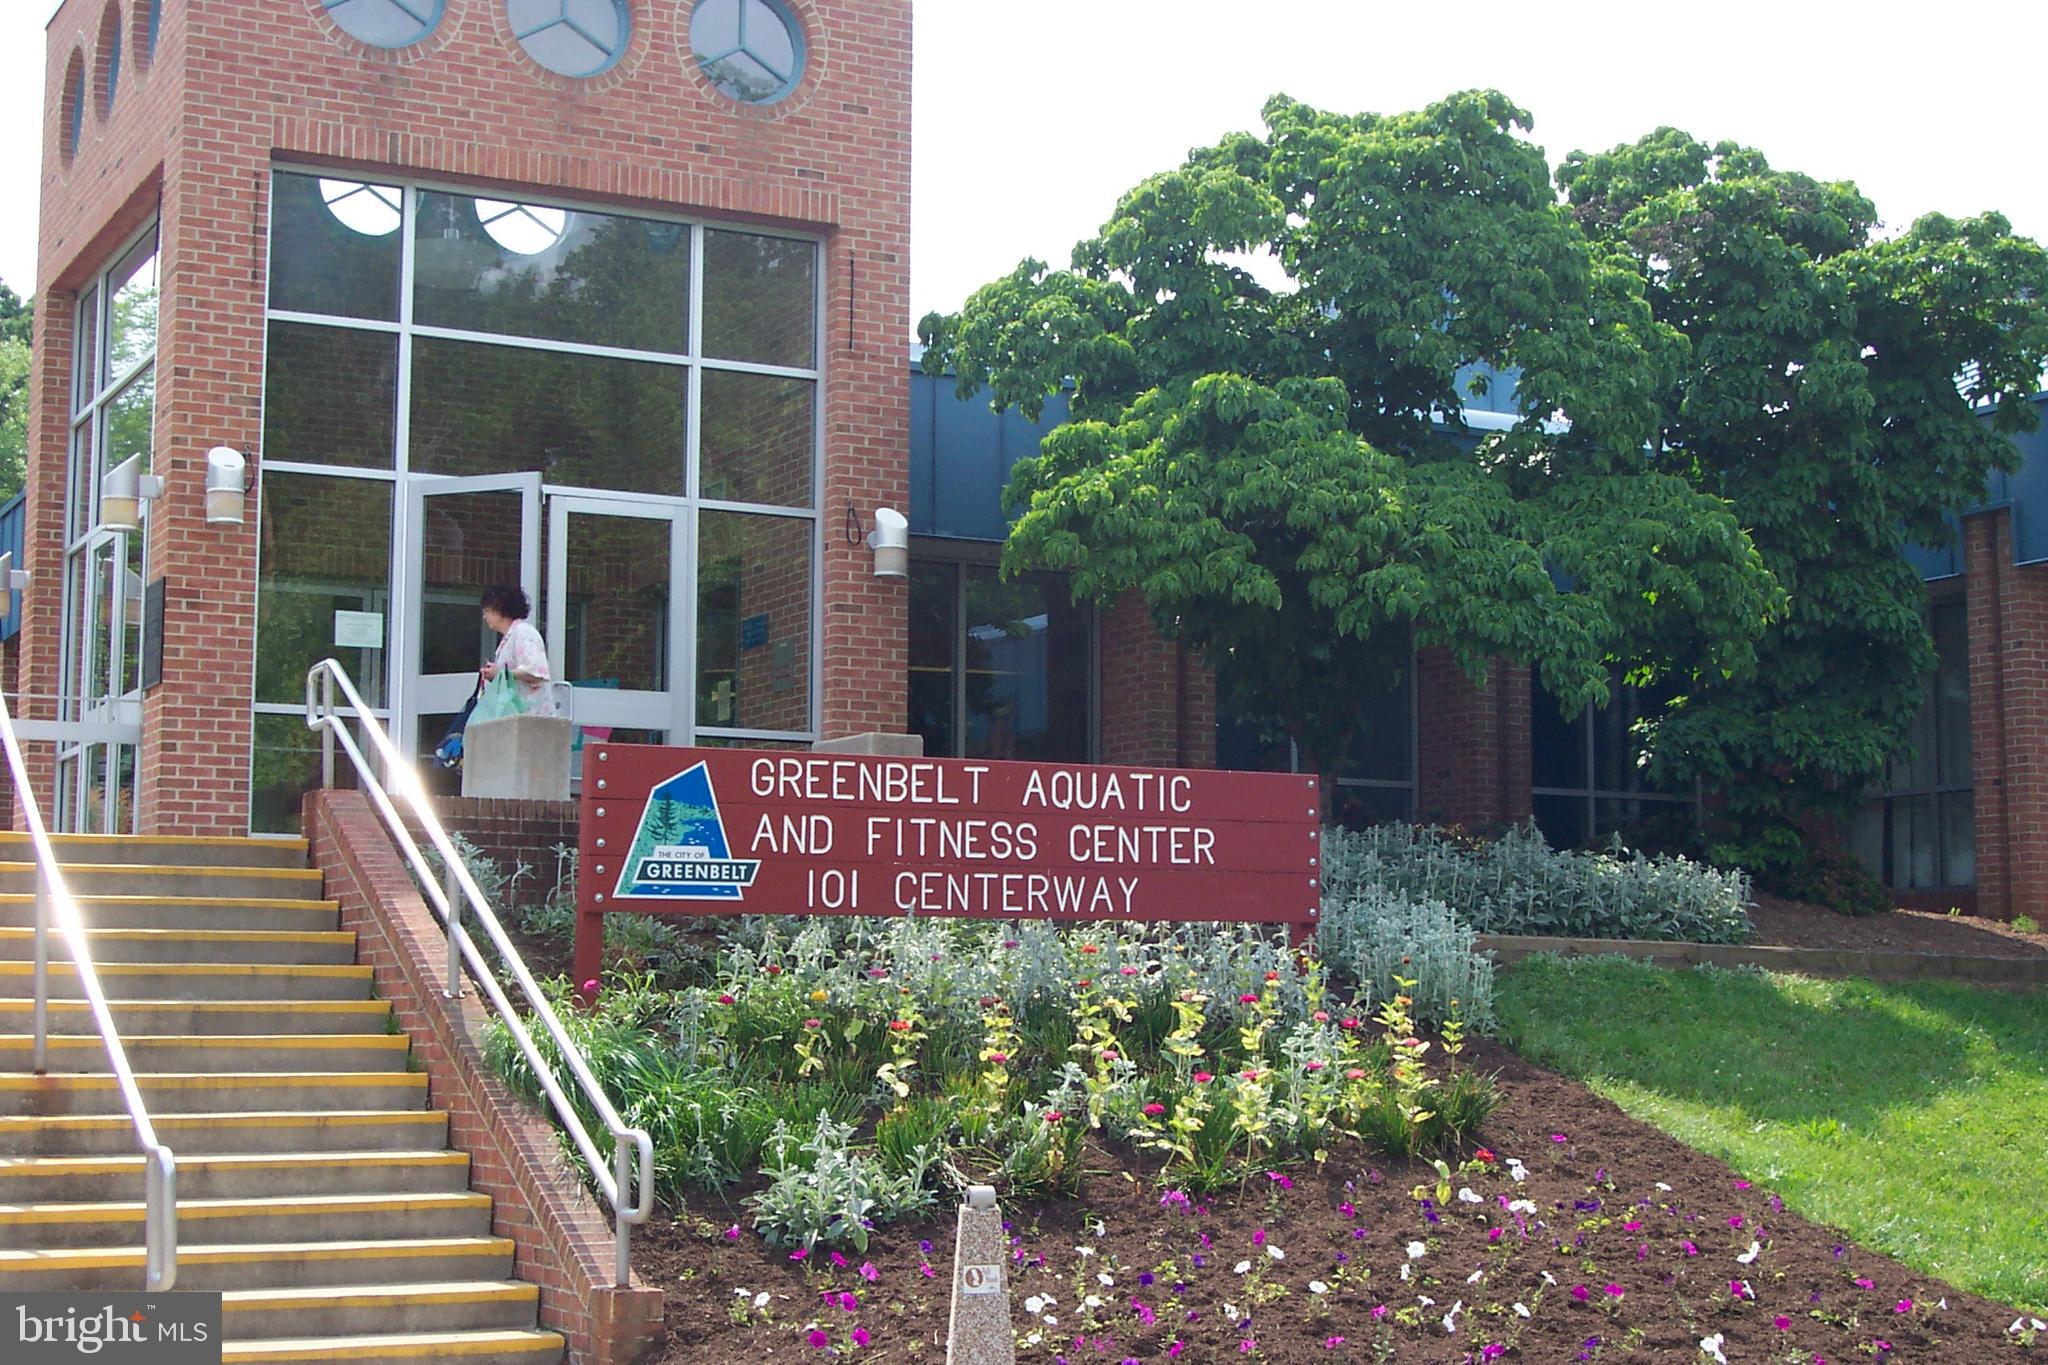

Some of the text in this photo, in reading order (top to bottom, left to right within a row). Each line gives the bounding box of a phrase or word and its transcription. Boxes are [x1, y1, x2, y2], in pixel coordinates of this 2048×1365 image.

[750, 757, 1193, 812] GREENBELT AQUATIC
[675, 851, 690, 859] CITY
[751, 813, 1216, 865] AND FITNESS CENTER
[646, 863, 747, 880] GREENBELT
[807, 869, 1139, 914] 101 CENTERWAY
